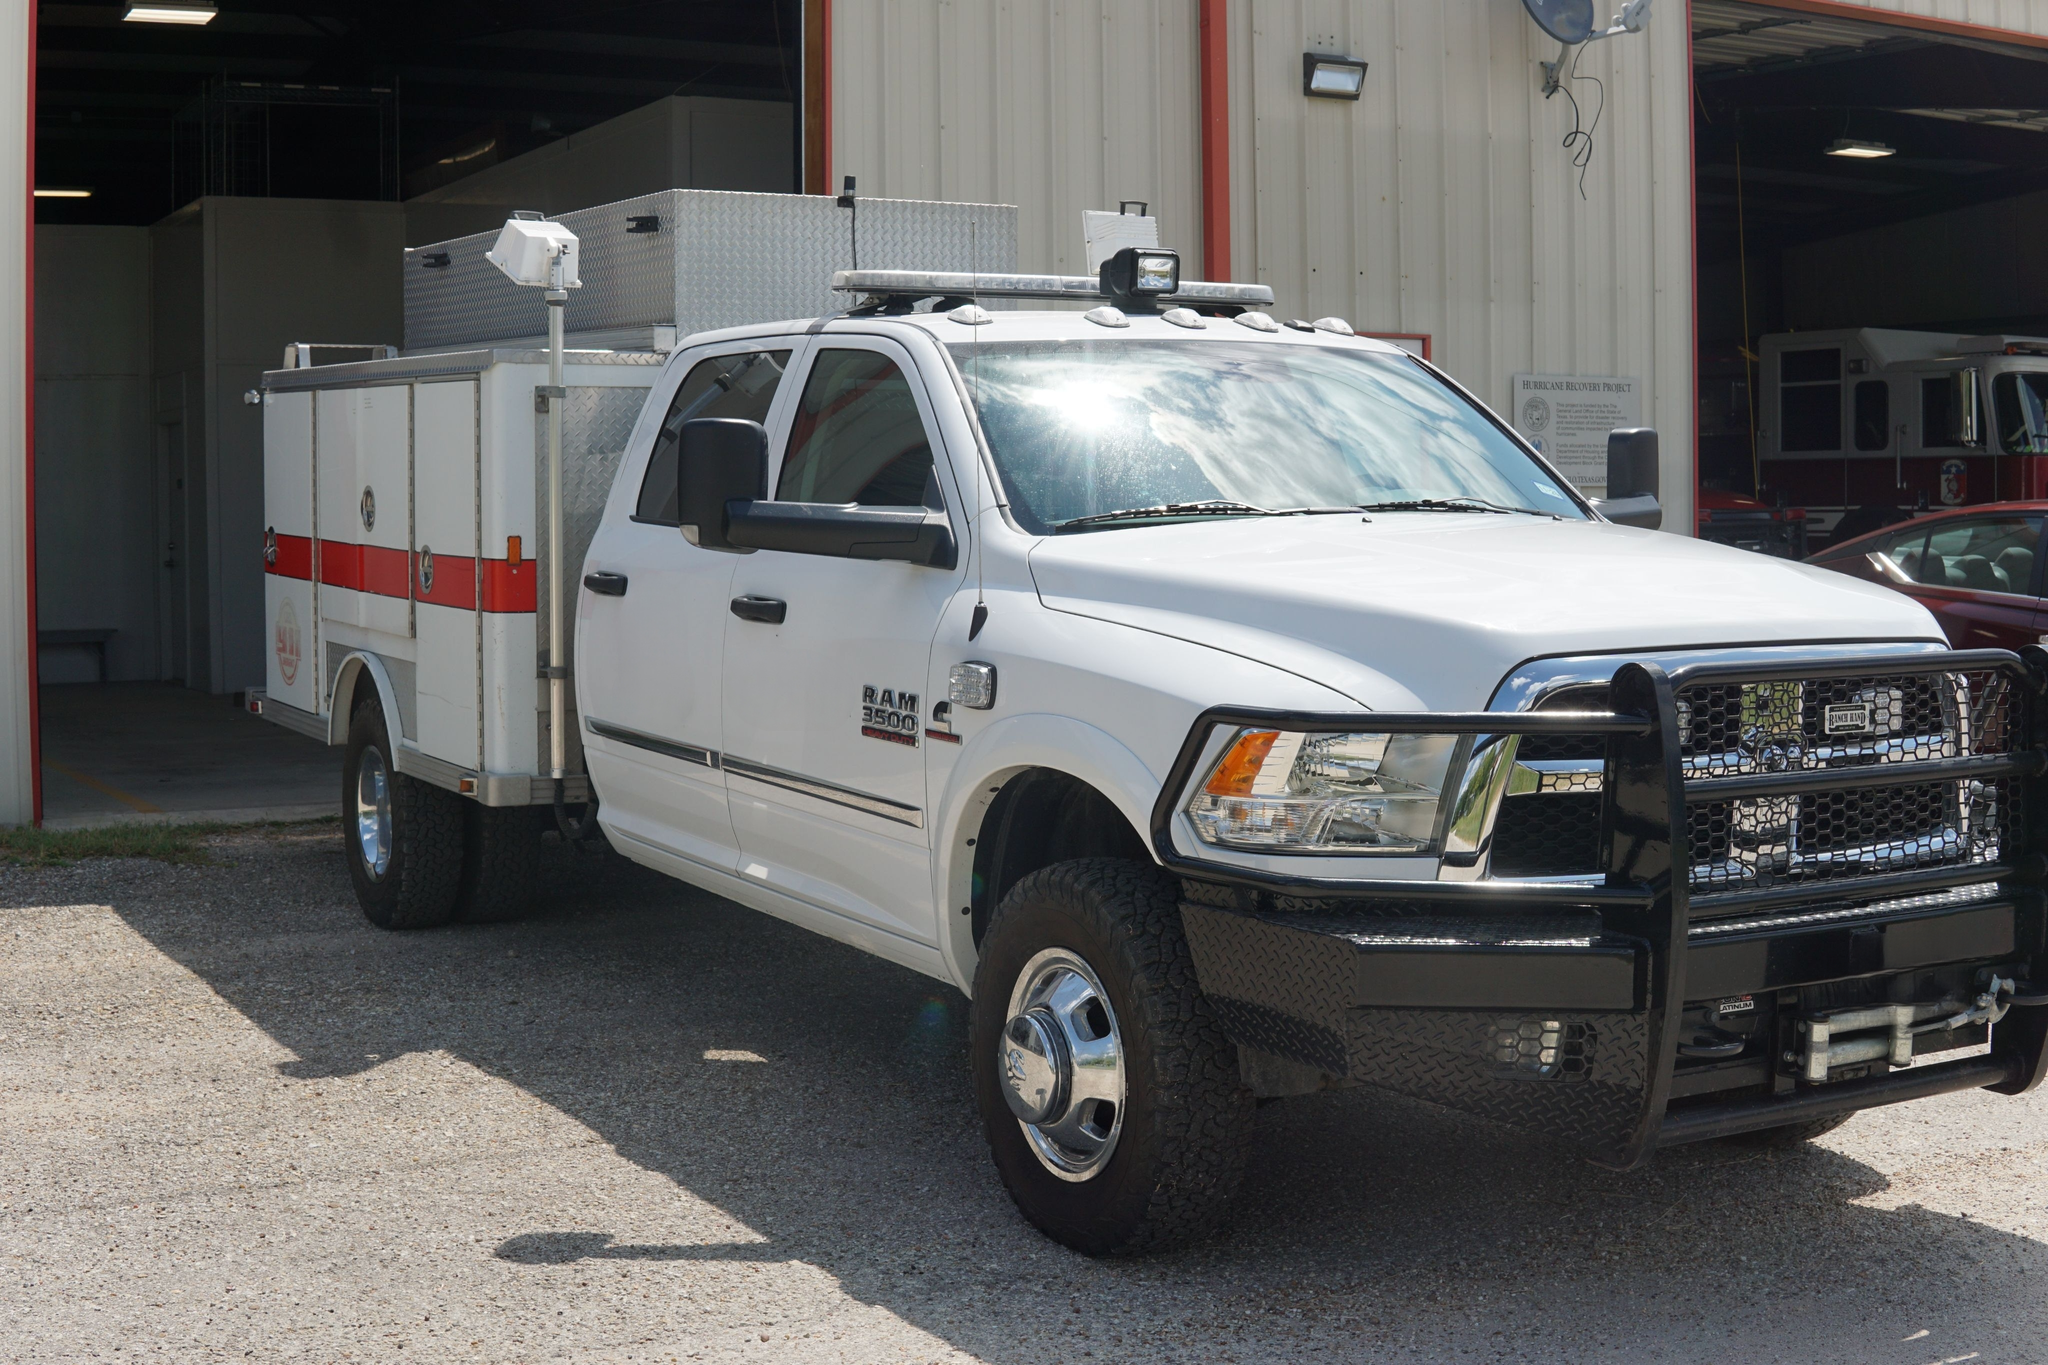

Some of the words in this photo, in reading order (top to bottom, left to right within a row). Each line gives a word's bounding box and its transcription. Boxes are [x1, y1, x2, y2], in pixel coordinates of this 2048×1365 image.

[1523, 380, 1564, 391] HURRICANE
[1566, 382, 1601, 392] RECOVERY
[1603, 383, 1631, 394] PROJECT
[862, 684, 920, 714] RAM
[862, 705, 919, 734] 3500
[1829, 713, 1848, 726] RANCH
[1850, 712, 1866, 724] HAND
[863, 728, 888, 740] HEAVY
[891, 734, 914, 745] DUTY
